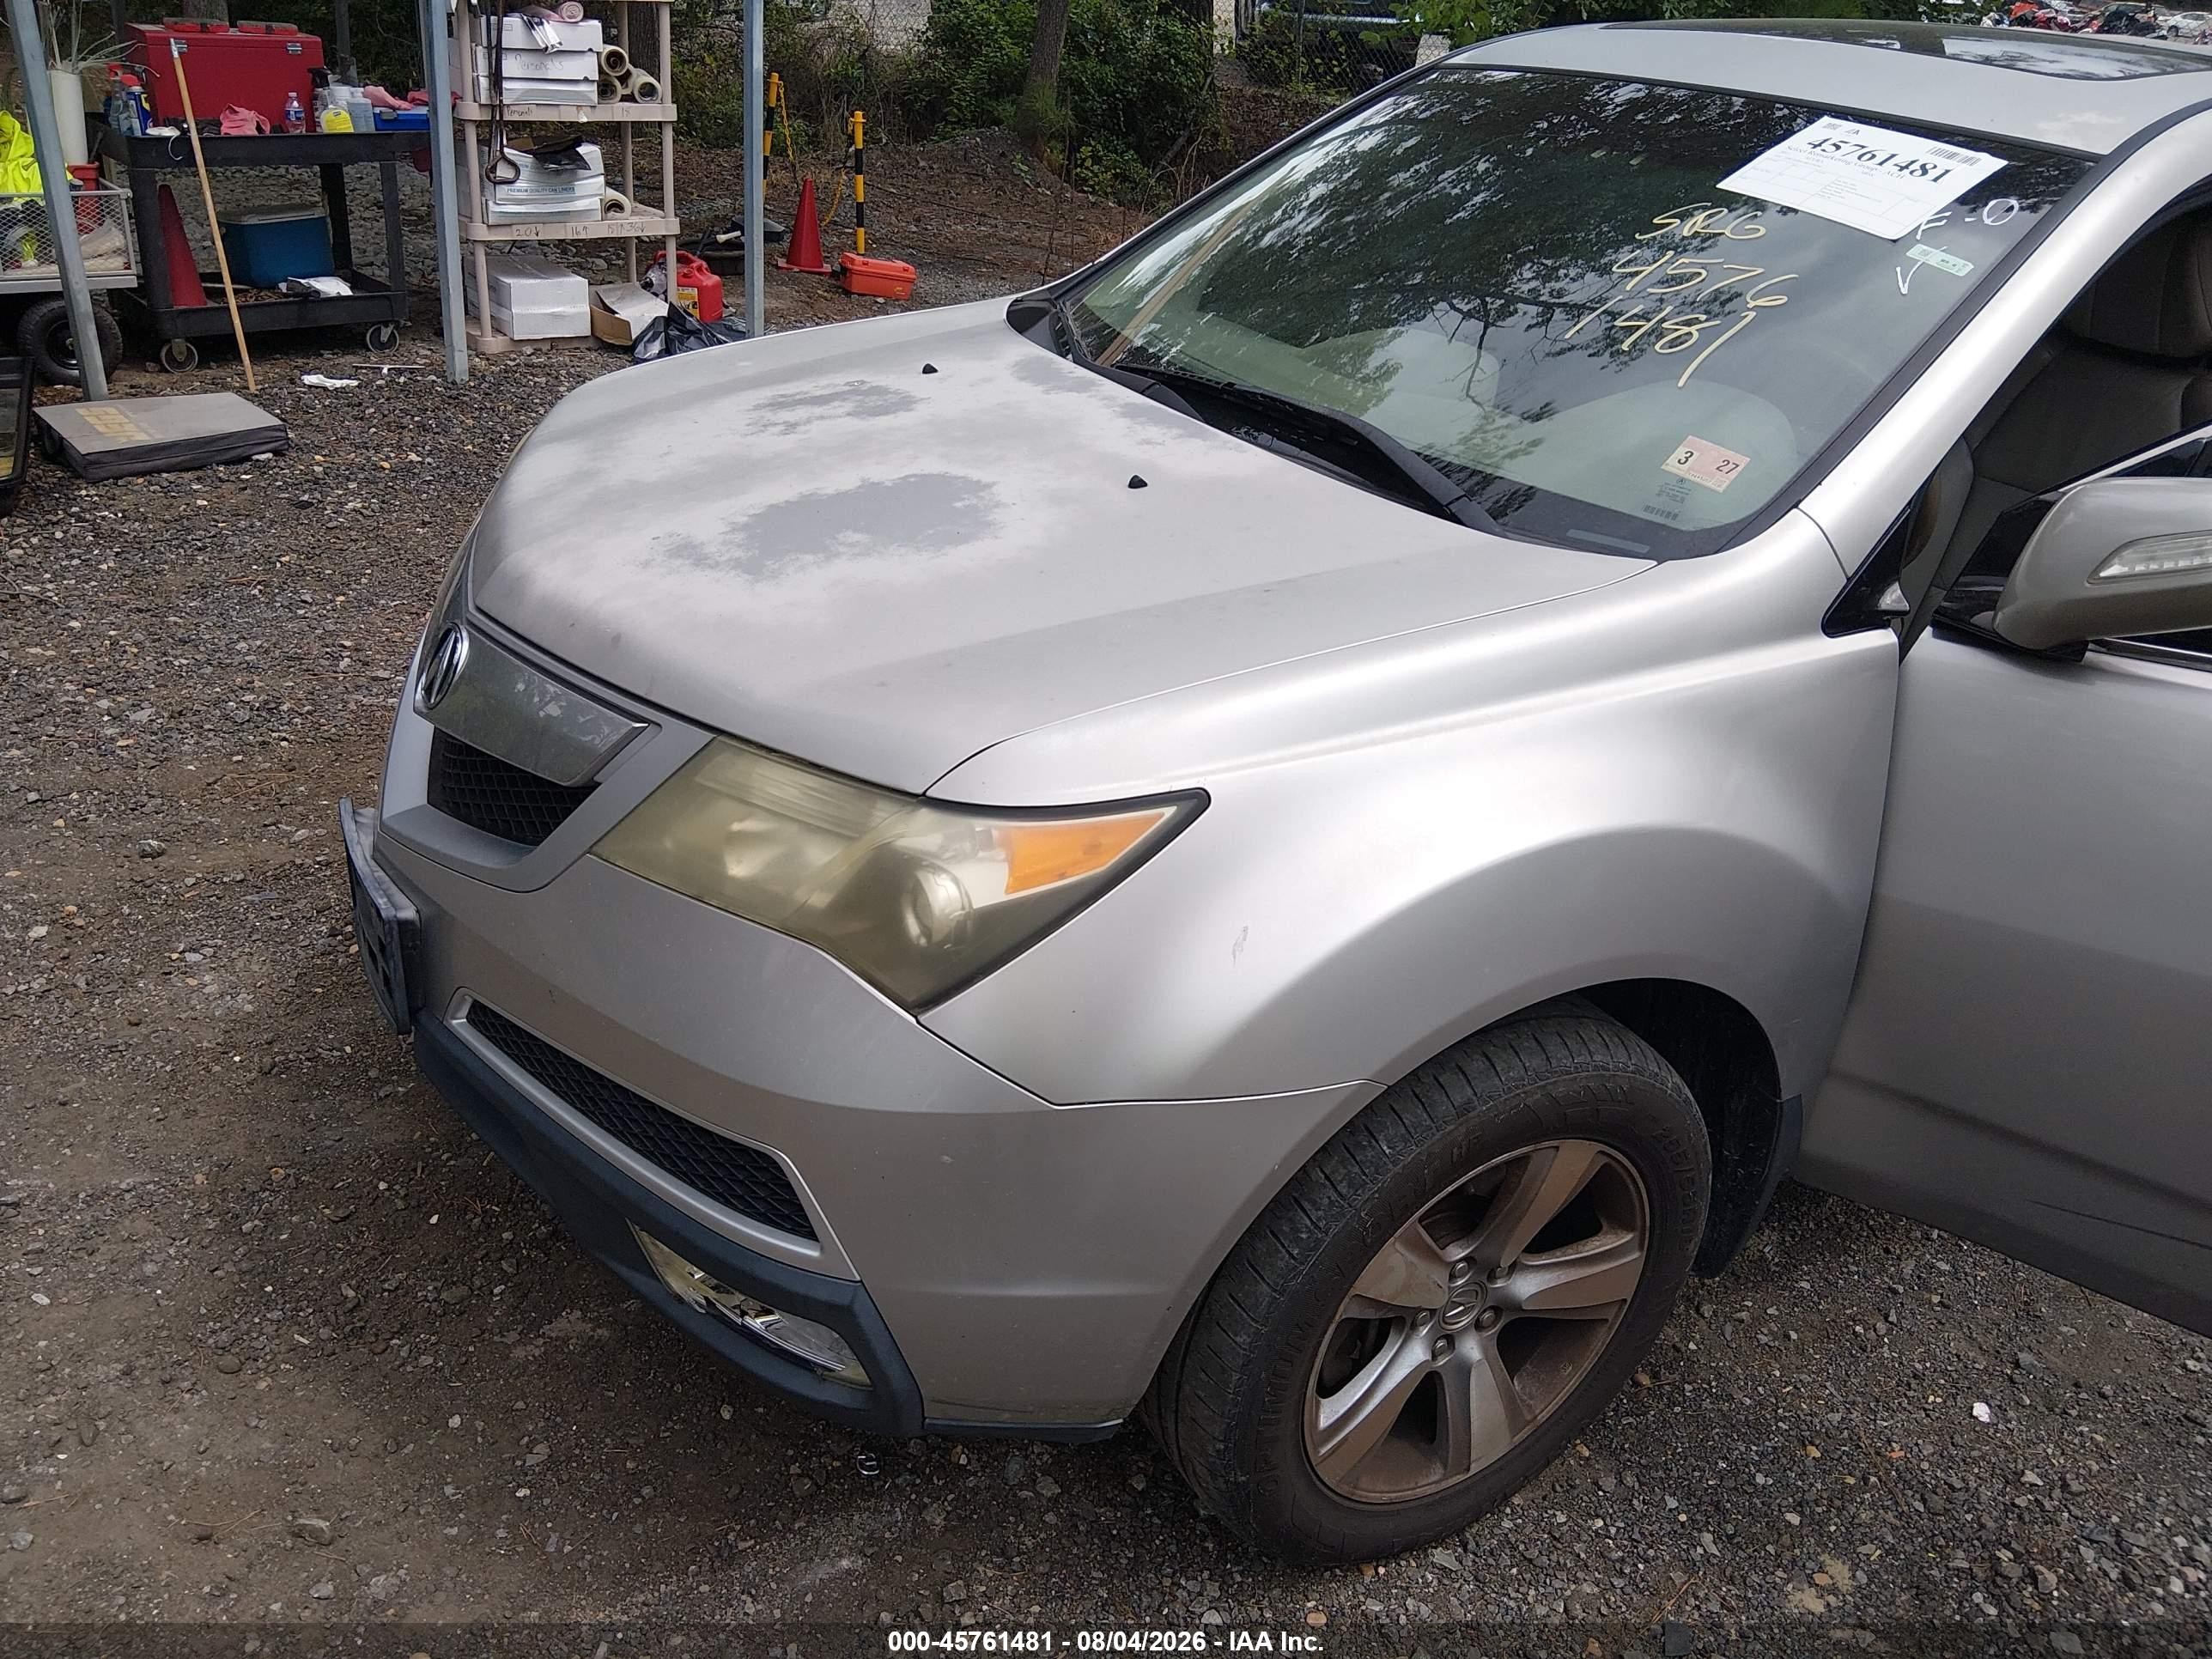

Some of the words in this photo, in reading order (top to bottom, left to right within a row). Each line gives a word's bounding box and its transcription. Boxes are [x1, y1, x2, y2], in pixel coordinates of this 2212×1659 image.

[1806, 137, 1953, 183] 45761481
[1611, 250, 1800, 309] 4576
[1564, 294, 1758, 389] 1481
[1677, 450, 1694, 465] 3
[1715, 459, 1740, 475] 27
